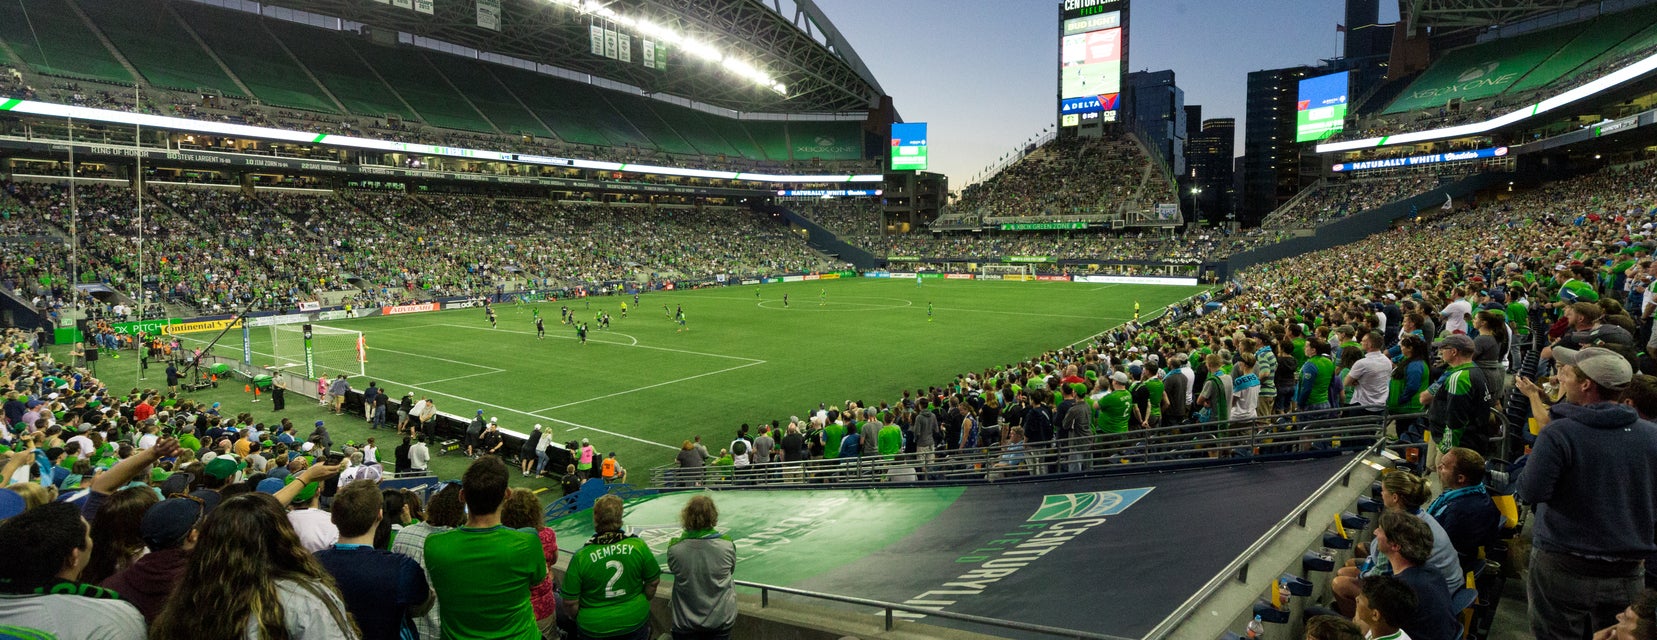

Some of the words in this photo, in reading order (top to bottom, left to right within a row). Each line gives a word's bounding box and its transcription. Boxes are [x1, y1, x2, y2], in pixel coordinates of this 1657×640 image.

[1080, 5, 1104, 15] FIELD
[1067, 20, 1087, 31] BUD
[1088, 16, 1116, 27] LIGHT
[1071, 101, 1100, 110] DELTA
[91, 146, 111, 155] RING
[178, 153, 194, 161] STEVE
[195, 155, 219, 163] LARGENT
[1353, 157, 1406, 171] NATURALLY
[1409, 154, 1441, 165] WHITE
[1444, 151, 1478, 162] Cheddar
[133, 323, 162, 333] PITCH
[164, 320, 215, 334] Continental
[1233, 374, 1257, 387] DERS
[955, 522, 1048, 563] FIELD
[590, 543, 634, 563] DEMPSEY
[605, 560, 626, 599] 2
